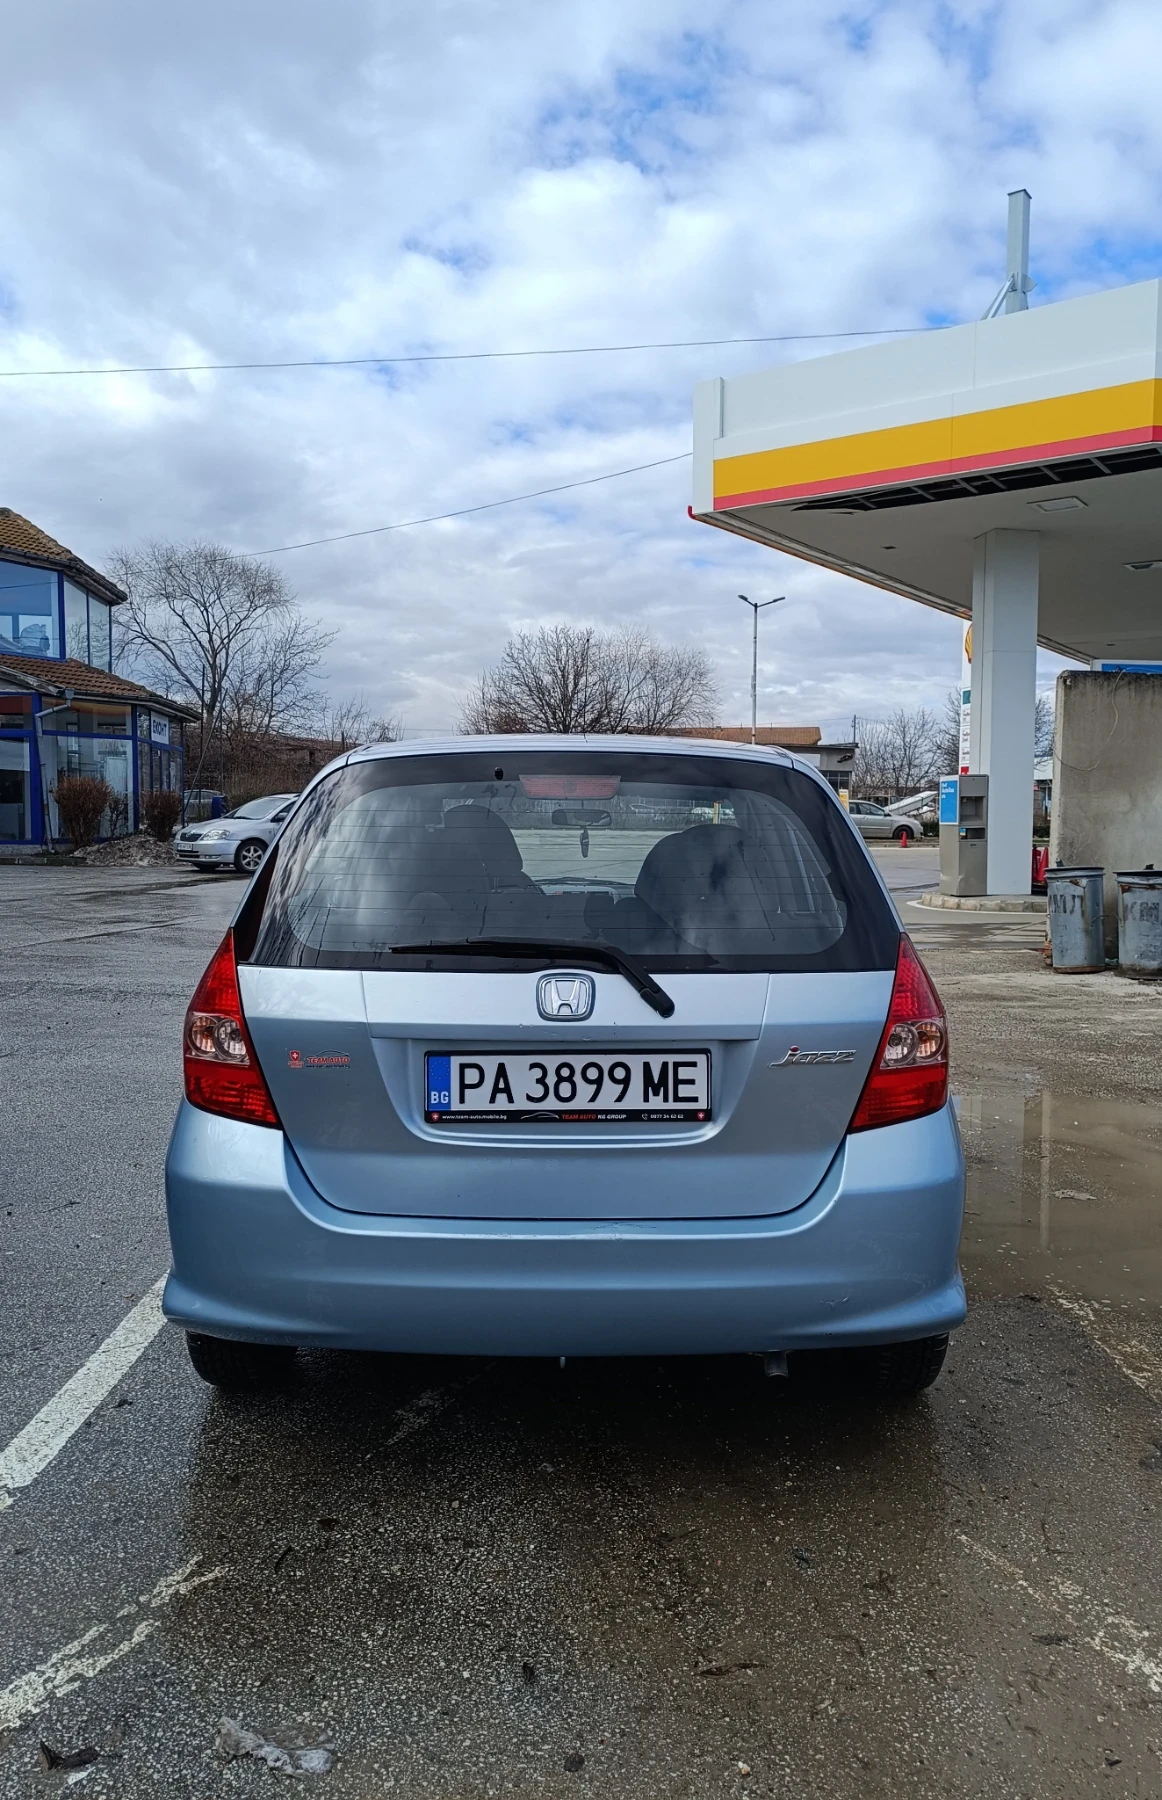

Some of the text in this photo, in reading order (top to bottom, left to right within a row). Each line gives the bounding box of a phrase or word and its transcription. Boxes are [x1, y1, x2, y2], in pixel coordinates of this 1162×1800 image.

[329, 1056, 350, 1064] AUTO
[458, 1061, 699, 1104] PA 3899 ME
[430, 1091, 449, 1104] BG
